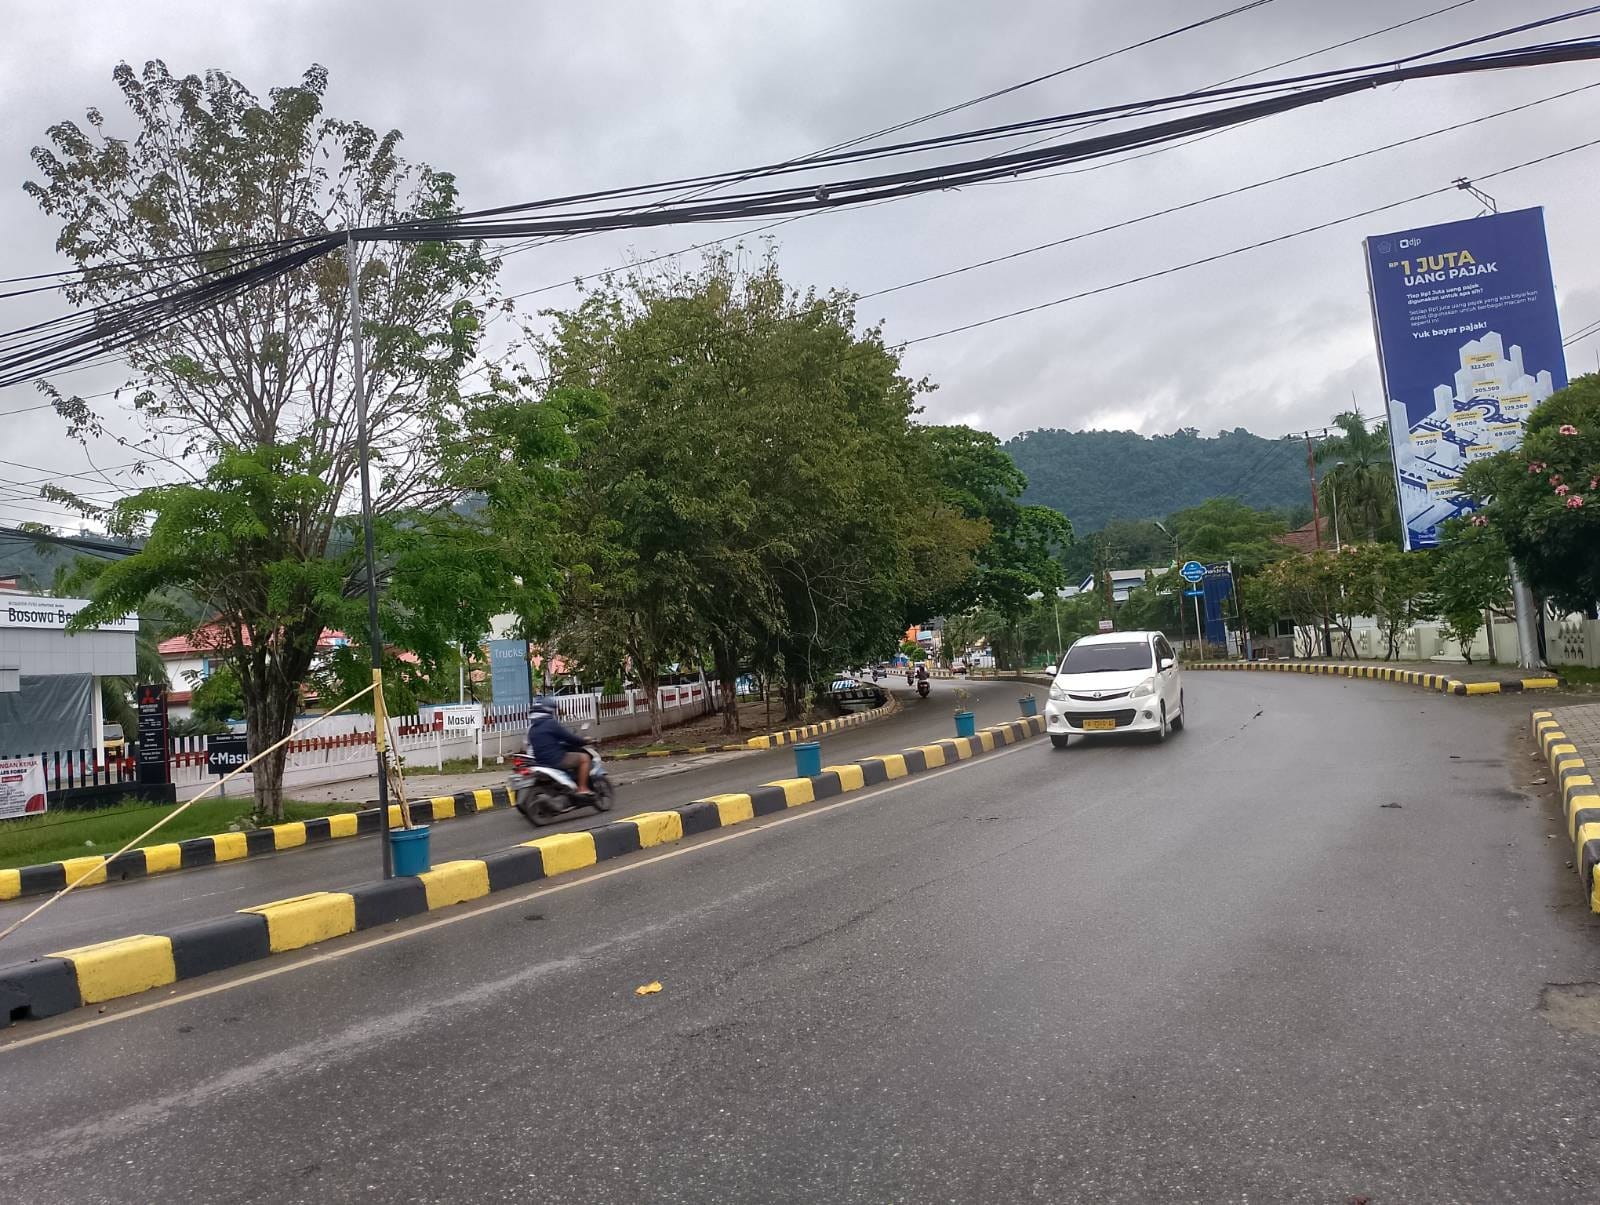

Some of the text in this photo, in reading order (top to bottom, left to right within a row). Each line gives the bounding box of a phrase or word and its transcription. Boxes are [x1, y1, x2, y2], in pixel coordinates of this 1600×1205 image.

[1409, 237, 1422, 247] djp
[1401, 260, 1411, 275] 1
[1416, 250, 1476, 273] JUTA
[1404, 262, 1498, 287] UANG PAJAK
[1412, 321, 1487, 339] Yuk bayar pajak!
[8, 607, 54, 624] Bosowa
[495, 648, 523, 658] Trucks
[447, 713, 476, 726] Masuk
[218, 751, 250, 765] Masu
